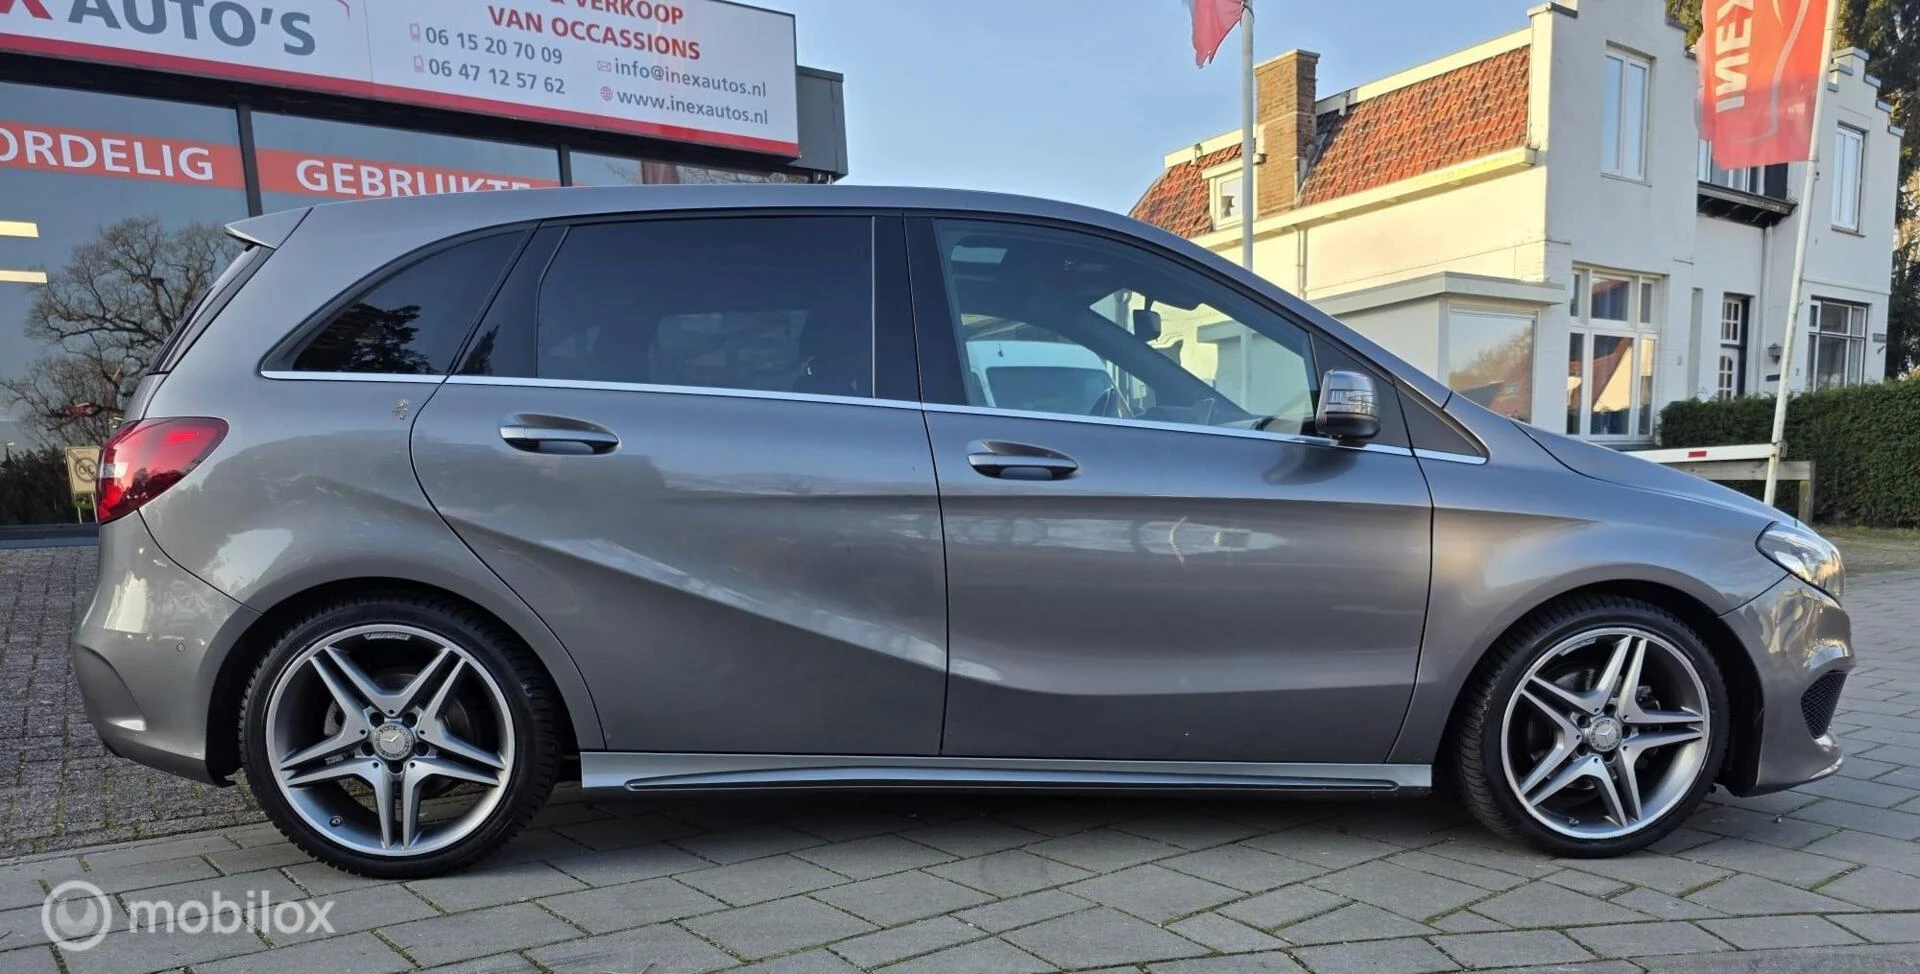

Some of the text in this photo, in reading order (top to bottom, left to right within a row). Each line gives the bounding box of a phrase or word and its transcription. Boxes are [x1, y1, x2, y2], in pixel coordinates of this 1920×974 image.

[426, 26, 563, 64] 06 15 20 70 09
[489, 5, 701, 60] VAN OCCASSIONS
[429, 58, 565, 94] 06 47 12 57 62
[615, 58, 767, 98] info@inexautos.nl
[617, 90, 769, 125] www.inexautos.nl
[296, 159, 531, 198] GEBRUI
